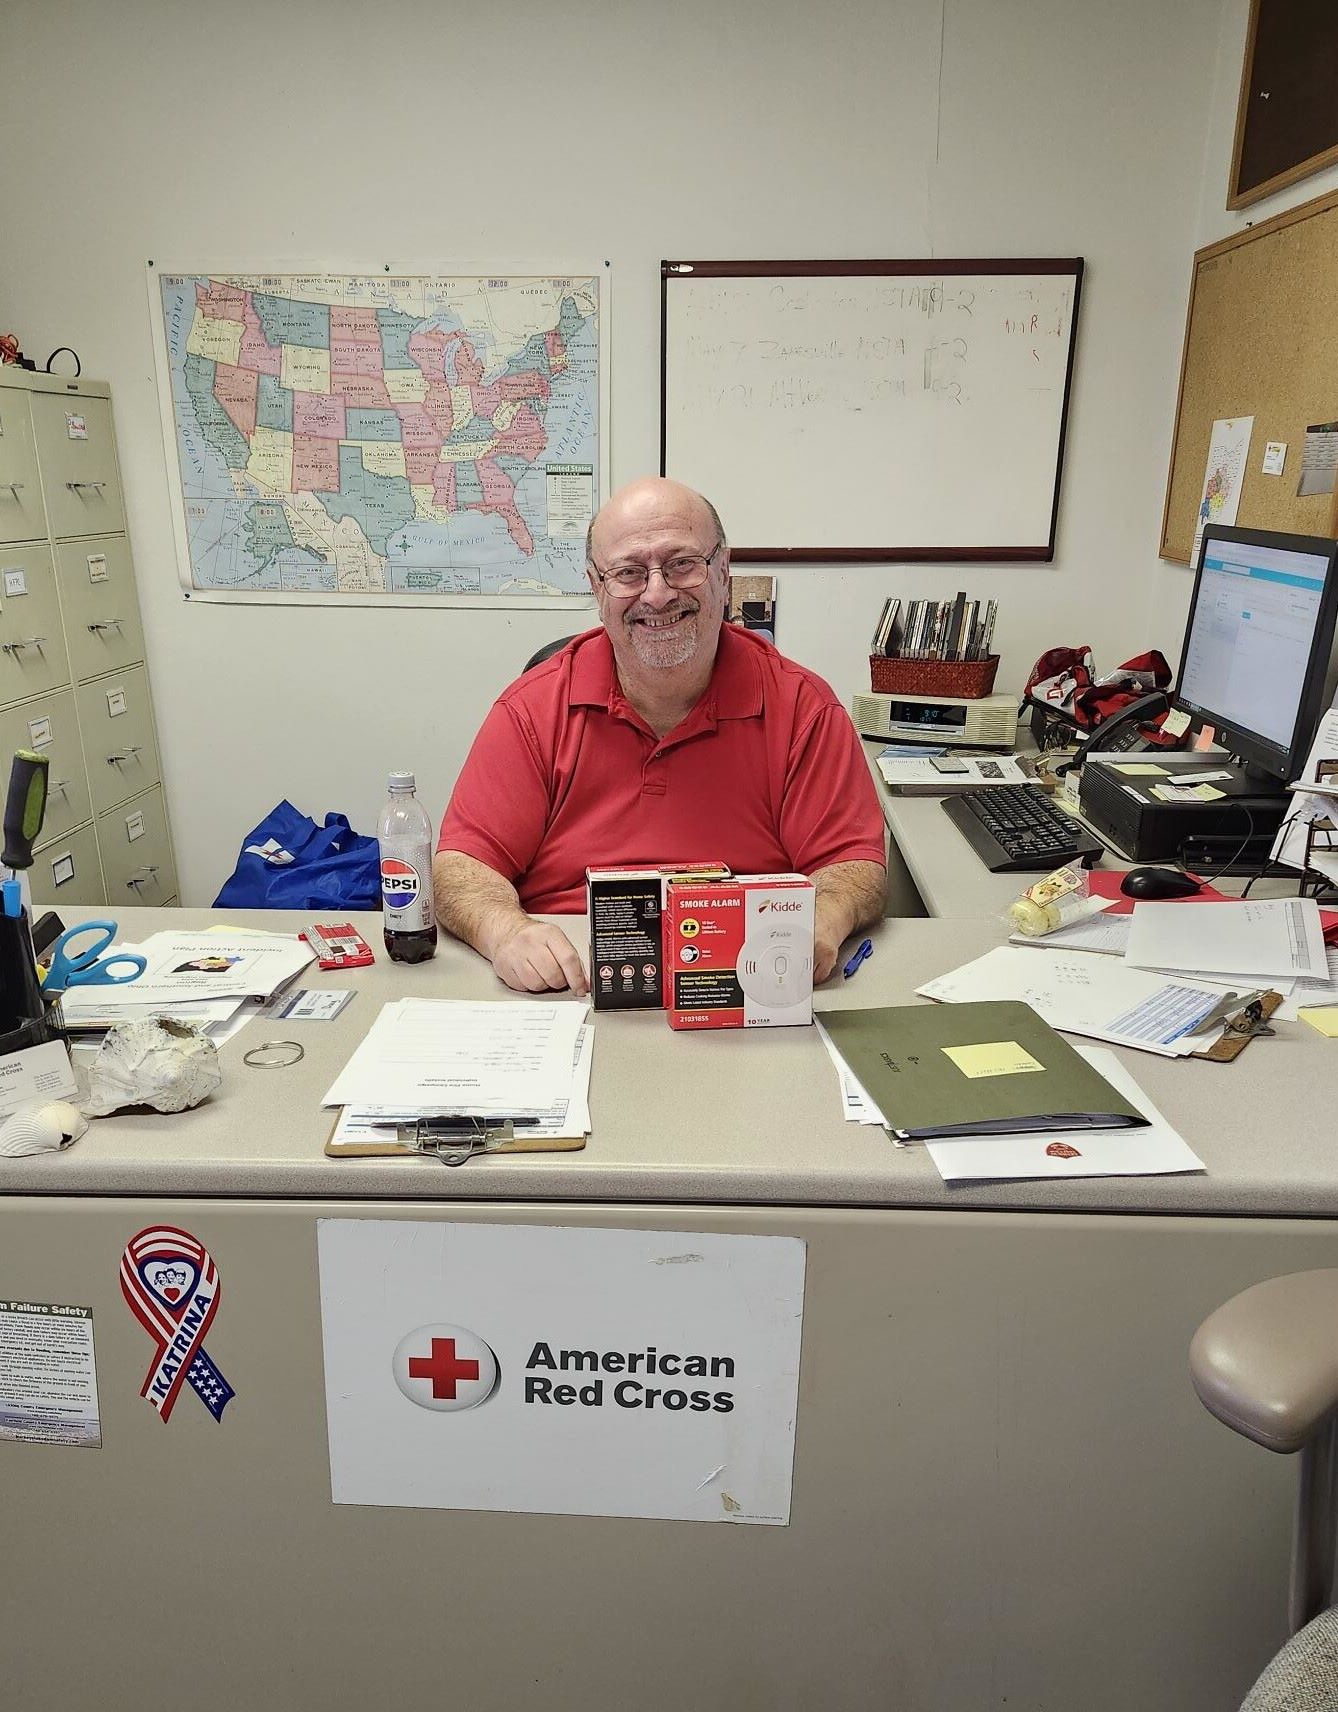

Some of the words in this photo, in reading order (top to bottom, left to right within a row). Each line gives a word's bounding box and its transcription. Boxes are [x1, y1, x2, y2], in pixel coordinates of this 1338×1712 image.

[569, 465, 592, 473] States
[680, 899, 709, 909] SMOKE
[710, 899, 741, 908] ALARM
[771, 902, 802, 912] Kidde
[6, 1067, 23, 1075] Cross
[11, 1302, 48, 1312] Failure
[52, 1306, 87, 1317] Safety
[152, 1293, 212, 1399] KATRINA
[525, 1341, 735, 1378] American
[524, 1377, 602, 1407] Red
[613, 1380, 734, 1413] Cross
